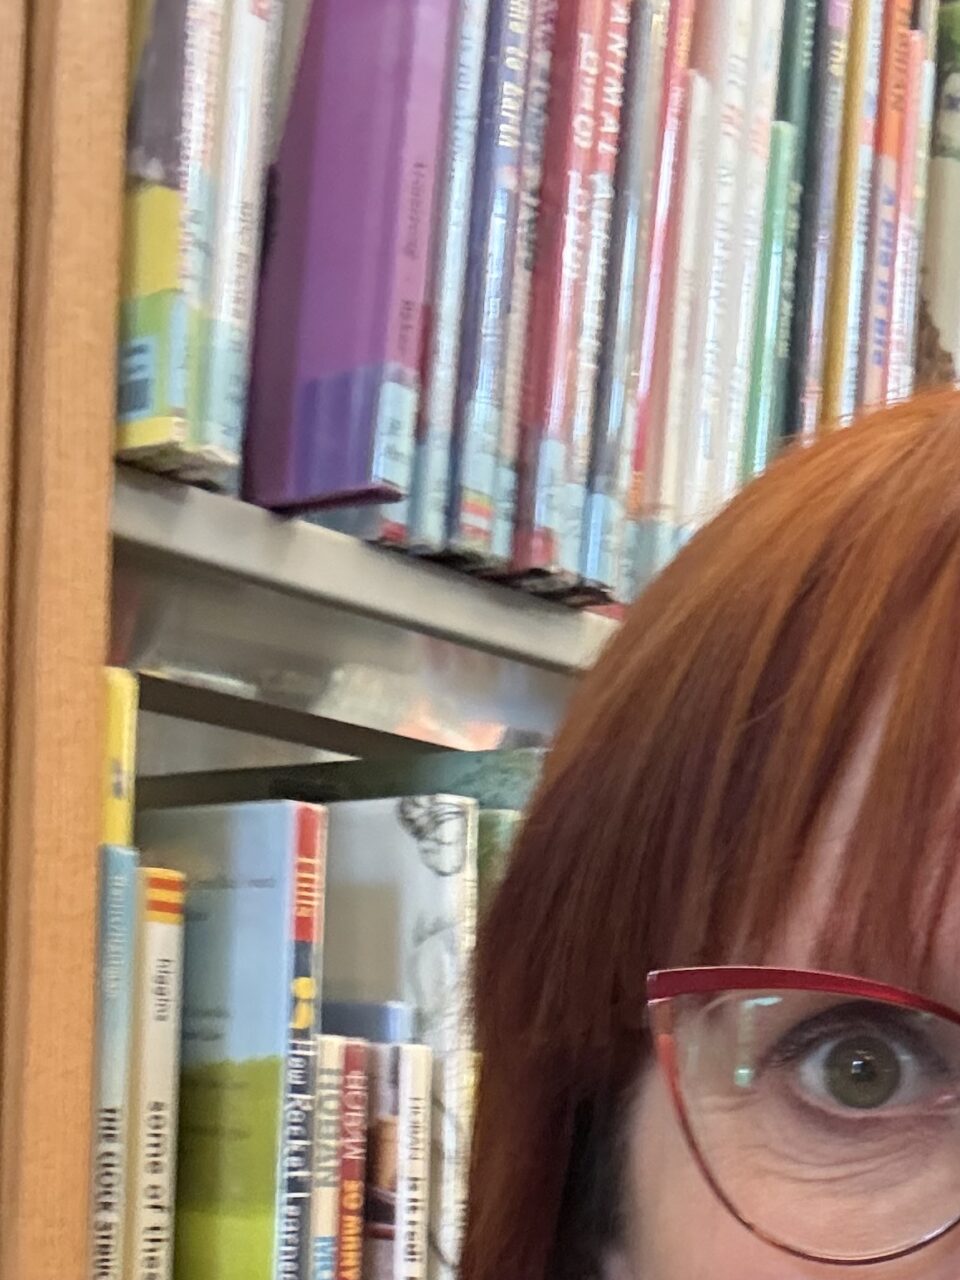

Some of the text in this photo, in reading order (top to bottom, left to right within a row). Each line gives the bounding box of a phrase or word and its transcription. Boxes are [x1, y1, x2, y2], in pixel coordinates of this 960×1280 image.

[597, 2, 631, 155] ANIMAL
[287, 1039, 318, 1085] How
[146, 1101, 169, 1174] some
[283, 1093, 316, 1180] Rocket
[97, 1150, 118, 1211] CLOCK
[143, 1185, 171, 1213] of
[338, 1215, 363, 1280] MANY
